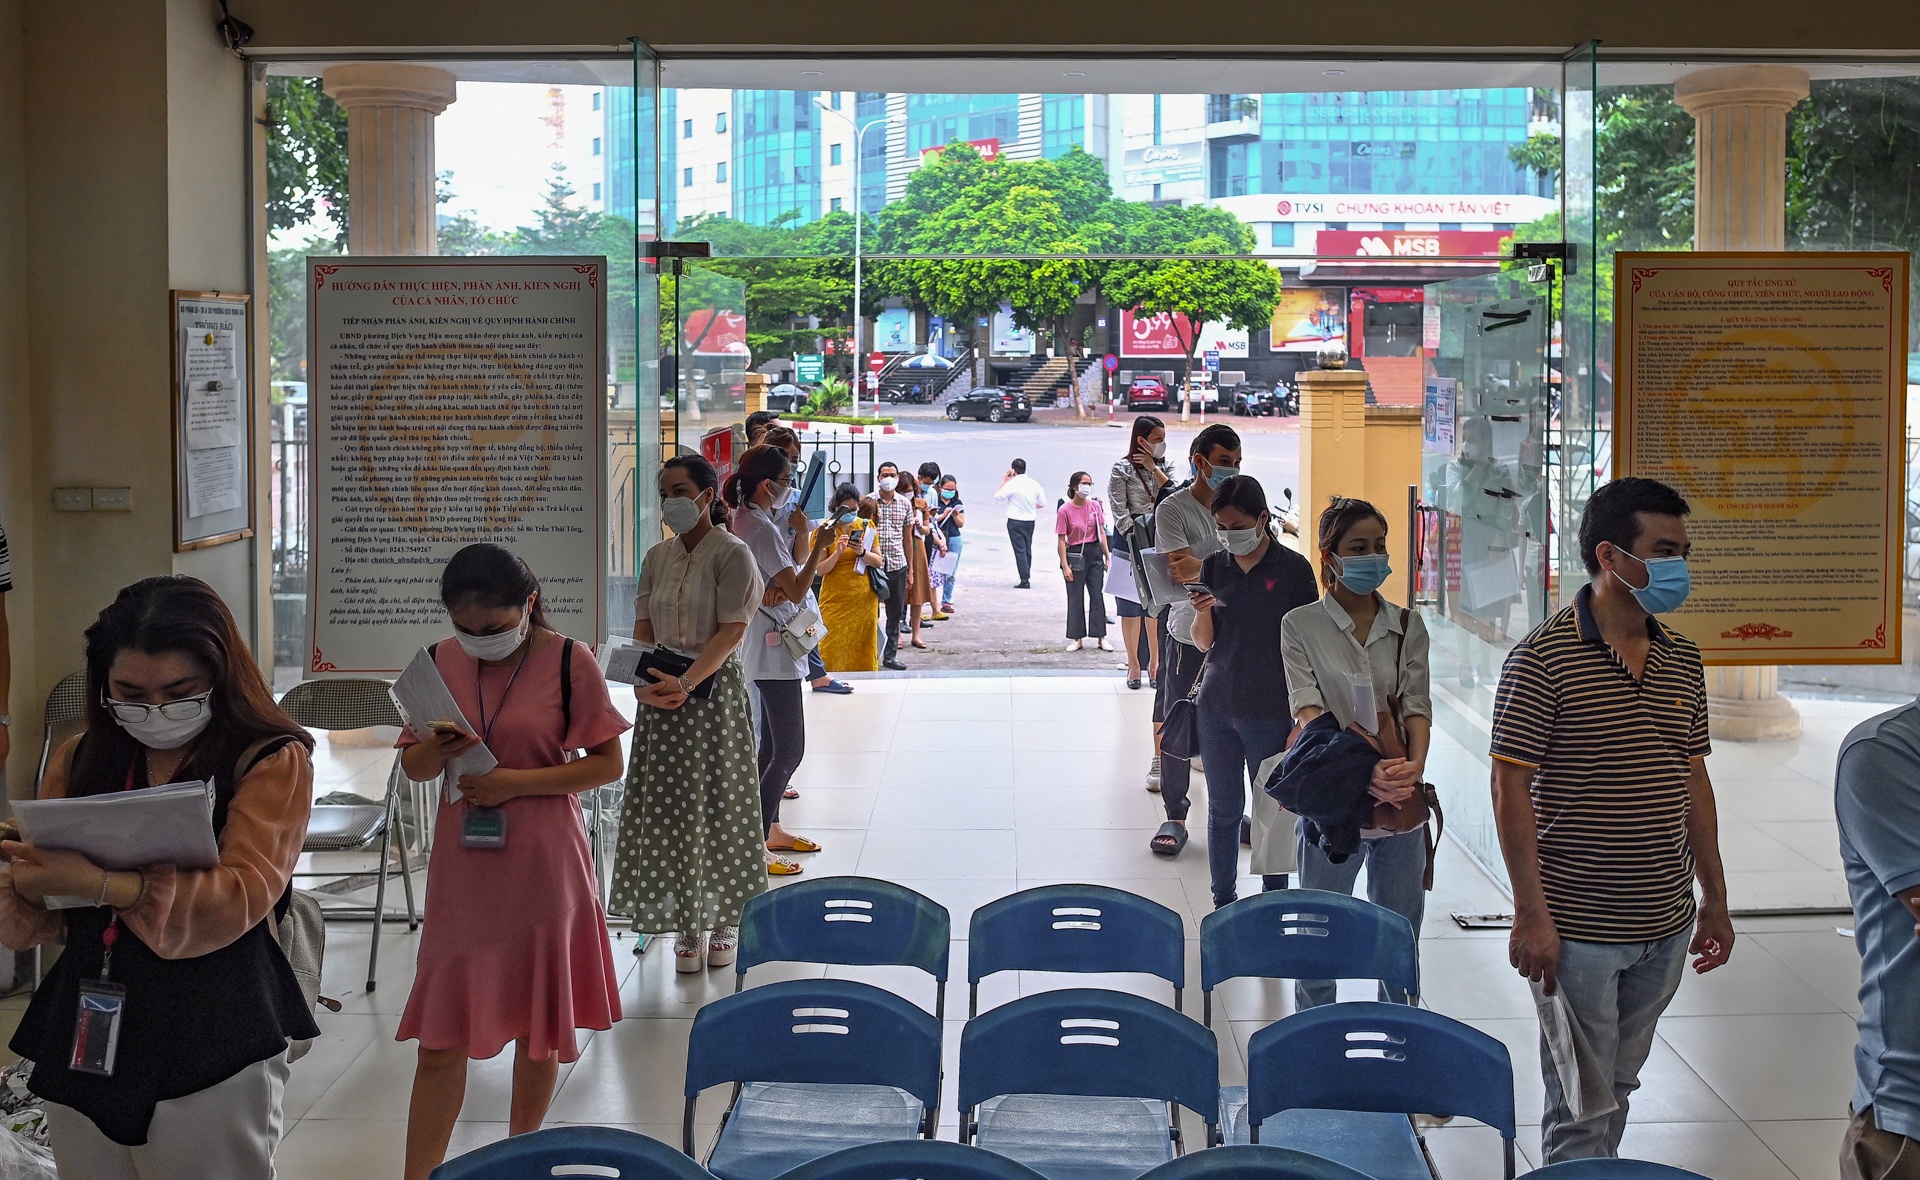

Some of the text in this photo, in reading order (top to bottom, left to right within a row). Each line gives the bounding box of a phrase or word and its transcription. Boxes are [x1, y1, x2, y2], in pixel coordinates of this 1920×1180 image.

[1294, 201, 1511, 215] TVSI CHỨNG KHOÁN TÂN VIỆT
[1394, 239, 1440, 256] MSB
[332, 279, 580, 292] HƯỚNG DẪN THỰC HIỆN, PHẢN ÁNH, KIẾN NGHỊ
[392, 294, 519, 306] CỦA CÁ NHÂN, TỔ CHỨC
[361, 317, 384, 326] NHẬN
[385, 316, 407, 324] PHẢN
[408, 316, 428, 325] ÁNH,
[429, 316, 448, 324] KIẾN
[472, 316, 484, 324] VỀ
[525, 316, 548, 324] HÀNH
[550, 316, 576, 324] CHÍNH
